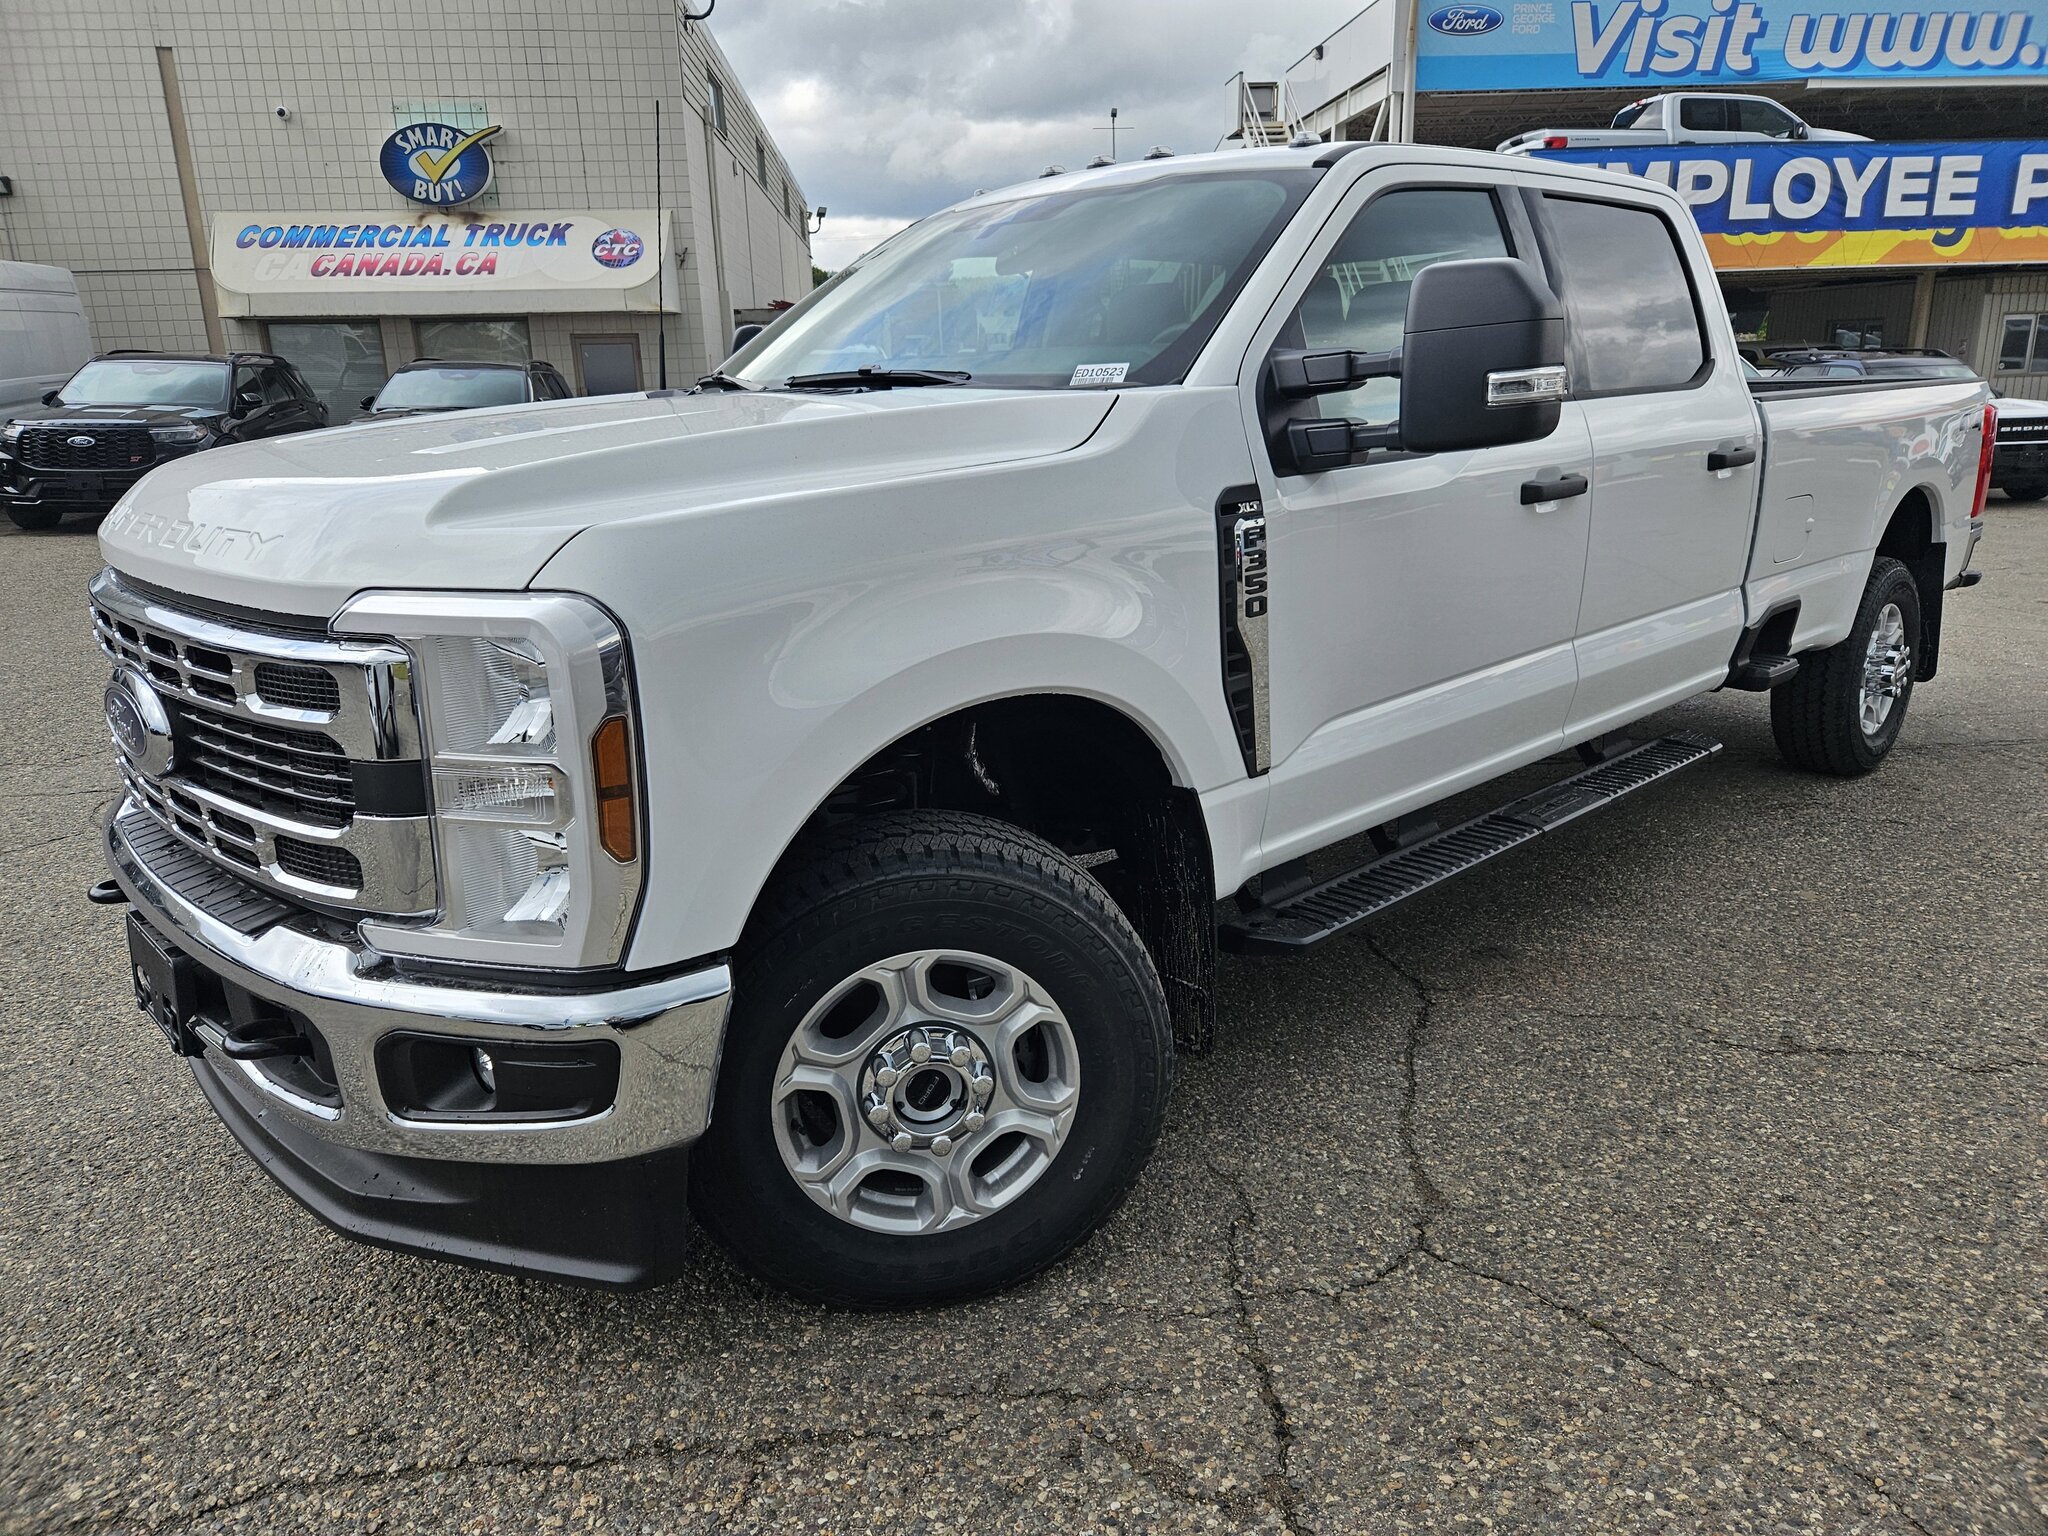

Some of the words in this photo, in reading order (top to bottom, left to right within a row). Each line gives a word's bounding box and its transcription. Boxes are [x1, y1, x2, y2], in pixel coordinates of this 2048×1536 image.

[1442, 8, 1490, 30] Ford
[1512, 14, 1555, 24] GEORGE
[1513, 3, 1553, 13] PRINCE
[1511, 25, 1540, 34] FORD
[1571, 0, 1764, 74] Visit
[1785, 12, 2048, 69] www.
[394, 126, 467, 155] SMART
[413, 179, 466, 202] BUY!
[1574, 155, 1984, 220] PLOYEE
[235, 223, 451, 249] COMMERCIAL
[463, 222, 575, 247] TRUCK
[593, 243, 640, 256] CTC
[310, 251, 498, 277] CANADA.CA
[1074, 367, 1124, 378] ED10523
[1238, 501, 1260, 513] XLT
